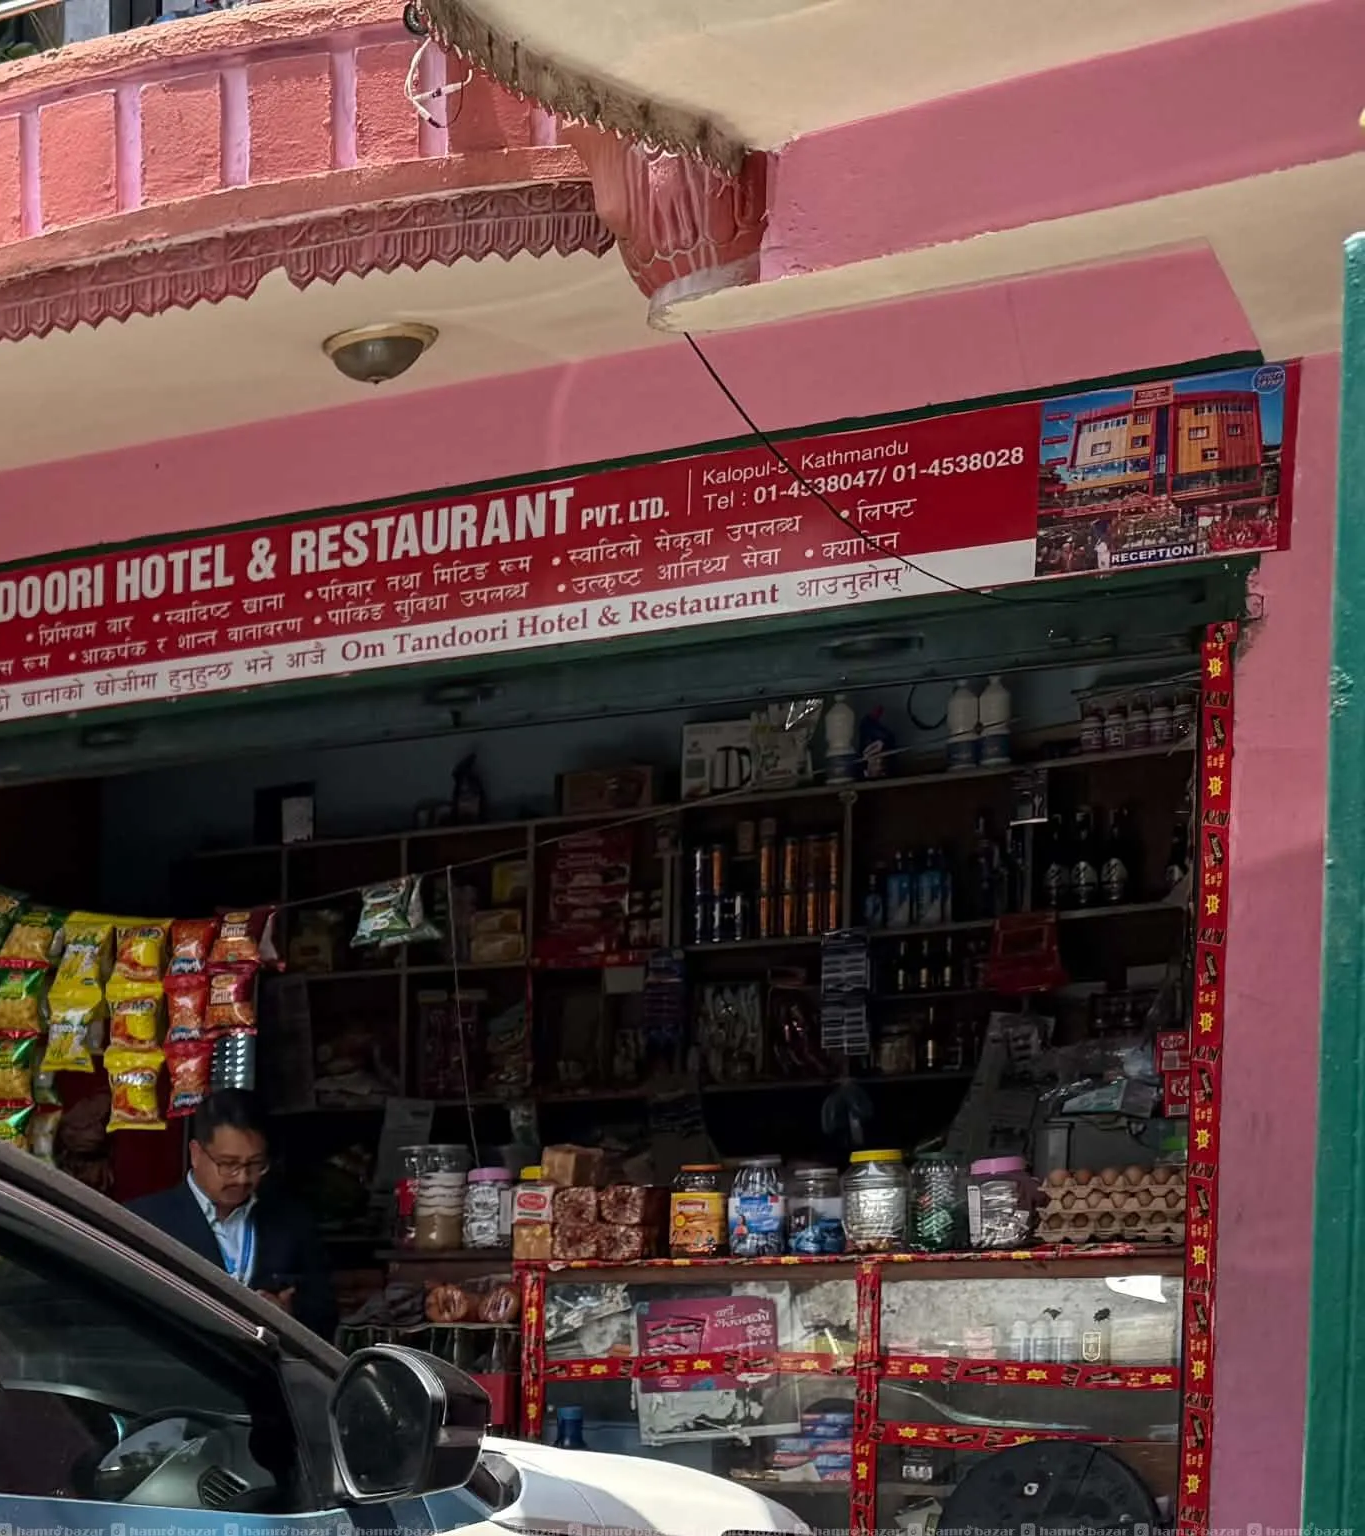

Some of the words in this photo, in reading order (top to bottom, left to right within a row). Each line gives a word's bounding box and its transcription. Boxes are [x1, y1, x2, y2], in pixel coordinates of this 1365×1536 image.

[703, 491, 734, 512] Tel
[892, 447, 1024, 483] 01-4538028
[801, 440, 909, 471] Kathmandu
[116, 544, 235, 603] HOTEL
[247, 537, 278, 582] &
[291, 487, 575, 576] RESTAURANT
[580, 503, 624, 530] PVT.
[629, 497, 670, 523] LTD.
[242, 592, 285, 613] खाना
[317, 578, 376, 603] परिवार
[386, 572, 422, 592] तथा
[726, 514, 803, 543] उपलब्ध
[857, 498, 917, 524] लिफ्ट
[1111, 544, 1195, 564] RECEPTION
[21, 678, 84, 708] खानाको
[244, 651, 273, 675] भने
[286, 640, 327, 669] आजै
[341, 640, 386, 662] Om
[393, 619, 509, 655] Tandoori
[517, 608, 588, 645] Hotel
[597, 605, 621, 627] &
[629, 584, 780, 622] Restaurant
[82, 636, 148, 664] आकर्षक
[157, 637, 168, 653] र
[178, 629, 218, 650] शान्त
[227, 617, 303, 643] वातावरण
[394, 592, 450, 624] सुविधा
[741, 545, 782, 569] सेवा
